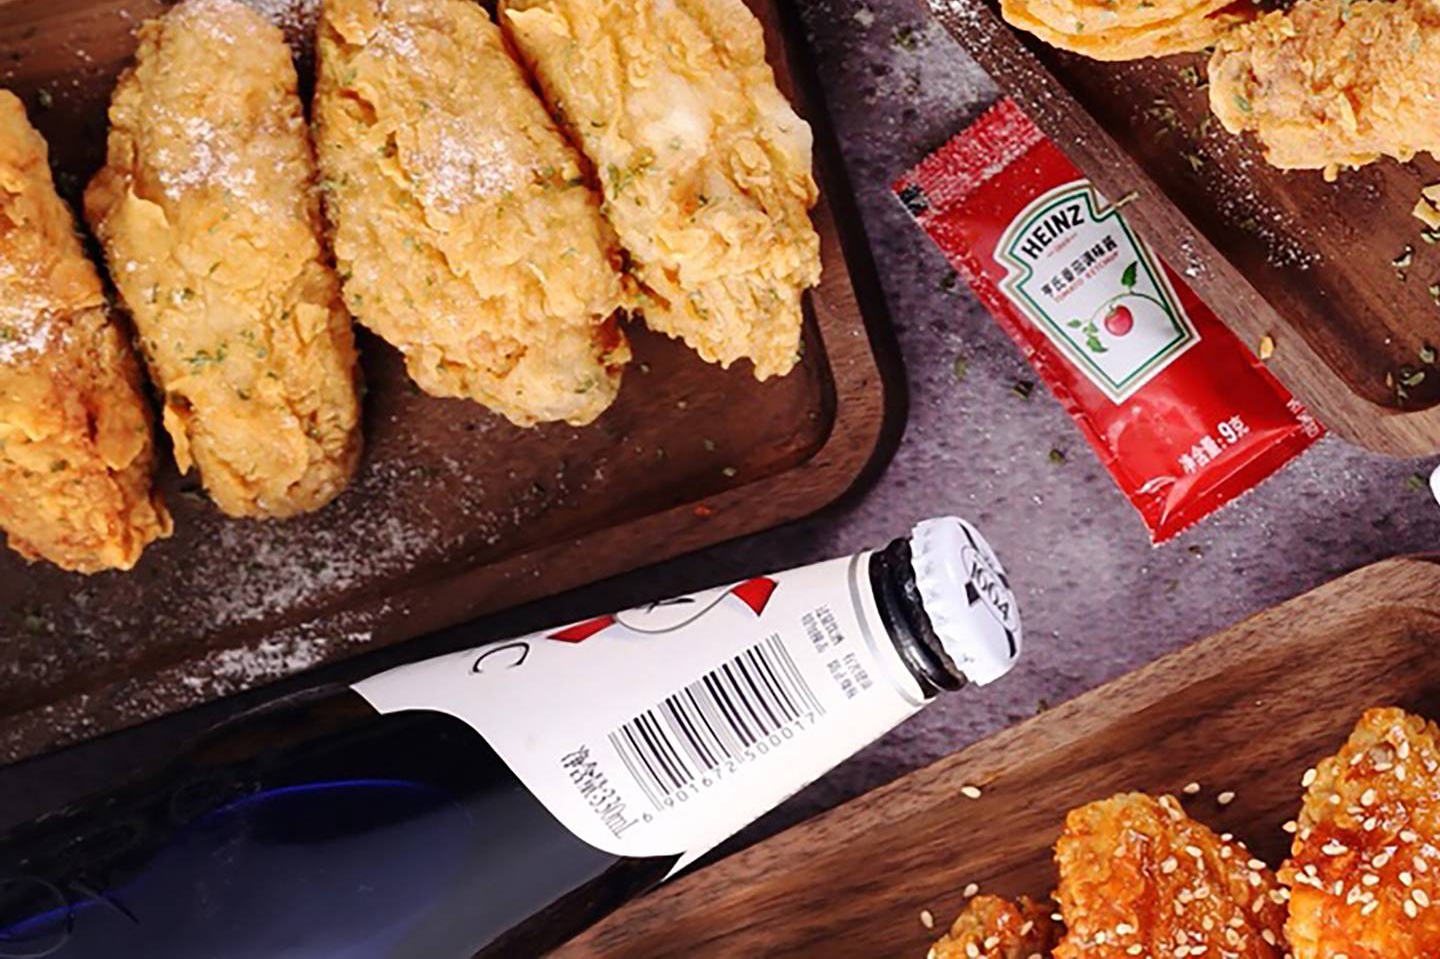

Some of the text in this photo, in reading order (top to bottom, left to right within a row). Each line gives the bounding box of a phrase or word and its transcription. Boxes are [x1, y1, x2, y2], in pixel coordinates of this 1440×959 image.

[1022, 204, 1085, 260] HEINZ
[665, 760, 737, 809] 901672
[745, 712, 815, 761] 500017
